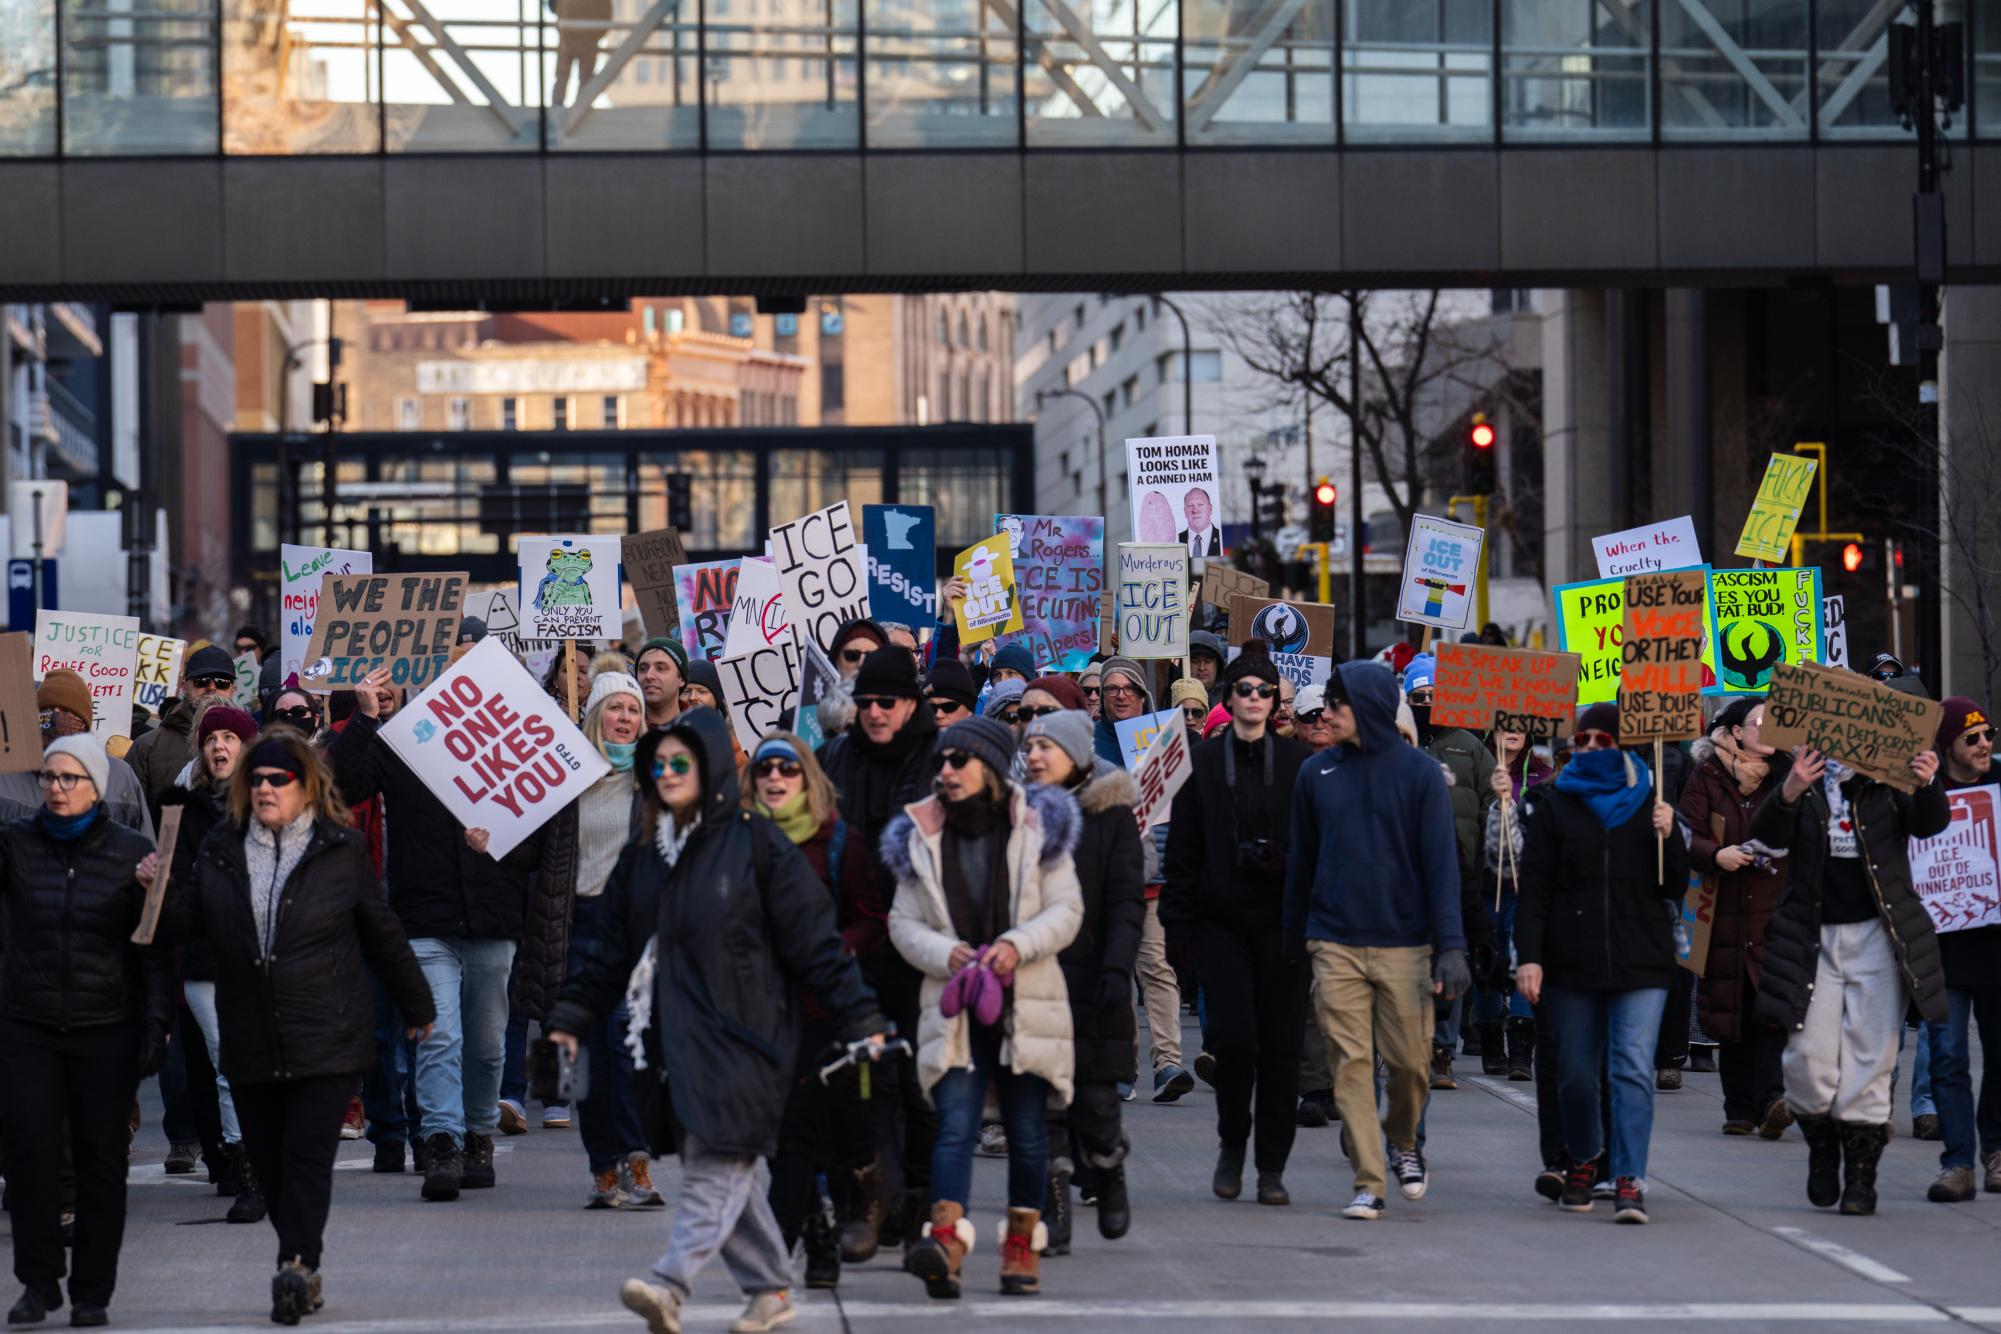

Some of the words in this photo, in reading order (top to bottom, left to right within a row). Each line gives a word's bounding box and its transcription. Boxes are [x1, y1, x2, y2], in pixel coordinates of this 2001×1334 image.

[1136, 446, 1162, 459] TOM
[1165, 444, 1209, 457] HOMAN
[1140, 460, 1179, 472] LOOKS
[1181, 458, 1208, 471] LIKE
[1137, 476, 1144, 485] A
[1146, 473, 1186, 485] CANNED
[1189, 472, 1212, 483] HAM
[1761, 458, 1810, 499] FUCK
[773, 503, 854, 574] ICE
[1743, 510, 1793, 549] ICE
[1429, 538, 1462, 557] ICE
[1606, 541, 1646, 557] When
[1654, 533, 1680, 546] the
[282, 551, 334, 583] Leave
[1120, 554, 1183, 573] Murderous
[1423, 552, 1464, 572] OUT
[1610, 557, 1662, 575] Cruelty
[798, 558, 856, 608] GO
[868, 556, 935, 614] RESIST
[966, 575, 1004, 599] ICE
[1067, 567, 1100, 593] IS
[333, 578, 389, 613] WE
[401, 577, 463, 612] THE
[963, 591, 1010, 619] OUT
[1121, 578, 1180, 610] ICE
[1627, 584, 1667, 608] USE
[1745, 588, 1780, 604] YOU
[533, 615, 559, 624] CAN
[565, 615, 603, 625] PREVENT
[541, 606, 569, 617] ONLY
[575, 606, 593, 617] YOU
[977, 611, 1011, 626] Minnesota
[1748, 603, 1785, 616] BUD!
[47, 622, 137, 650] JUSTICE
[321, 618, 455, 657] PEOPLE
[537, 624, 603, 637] FASCISM
[1125, 613, 1182, 645] OUT
[79, 645, 103, 657] FOR
[1273, 653, 1314, 670] HAVE
[90, 662, 128, 678] GOOD
[391, 655, 449, 686] OUT
[721, 641, 798, 706] ICE
[1531, 655, 1557, 676] UP
[1622, 666, 1698, 693] WILL
[1774, 665, 1819, 689] WHY
[1873, 688, 1926, 716] WOULD
[426, 675, 483, 728] NO
[1621, 691, 1656, 714] USE
[1657, 691, 1698, 713] YOUR
[1768, 681, 1897, 728] REPUBLICANS
[444, 692, 520, 762] ONE
[1493, 710, 1564, 738] RESIST
[1620, 713, 1696, 735] SILENCE
[1771, 705, 1806, 730] 90%
[453, 714, 555, 805] LIKES
[555, 743, 581, 771] GTFO
[1162, 734, 1185, 779] NO
[490, 752, 566, 818] YOU
[1928, 864, 1951, 879] OUT
[1955, 861, 1971, 875] OF
